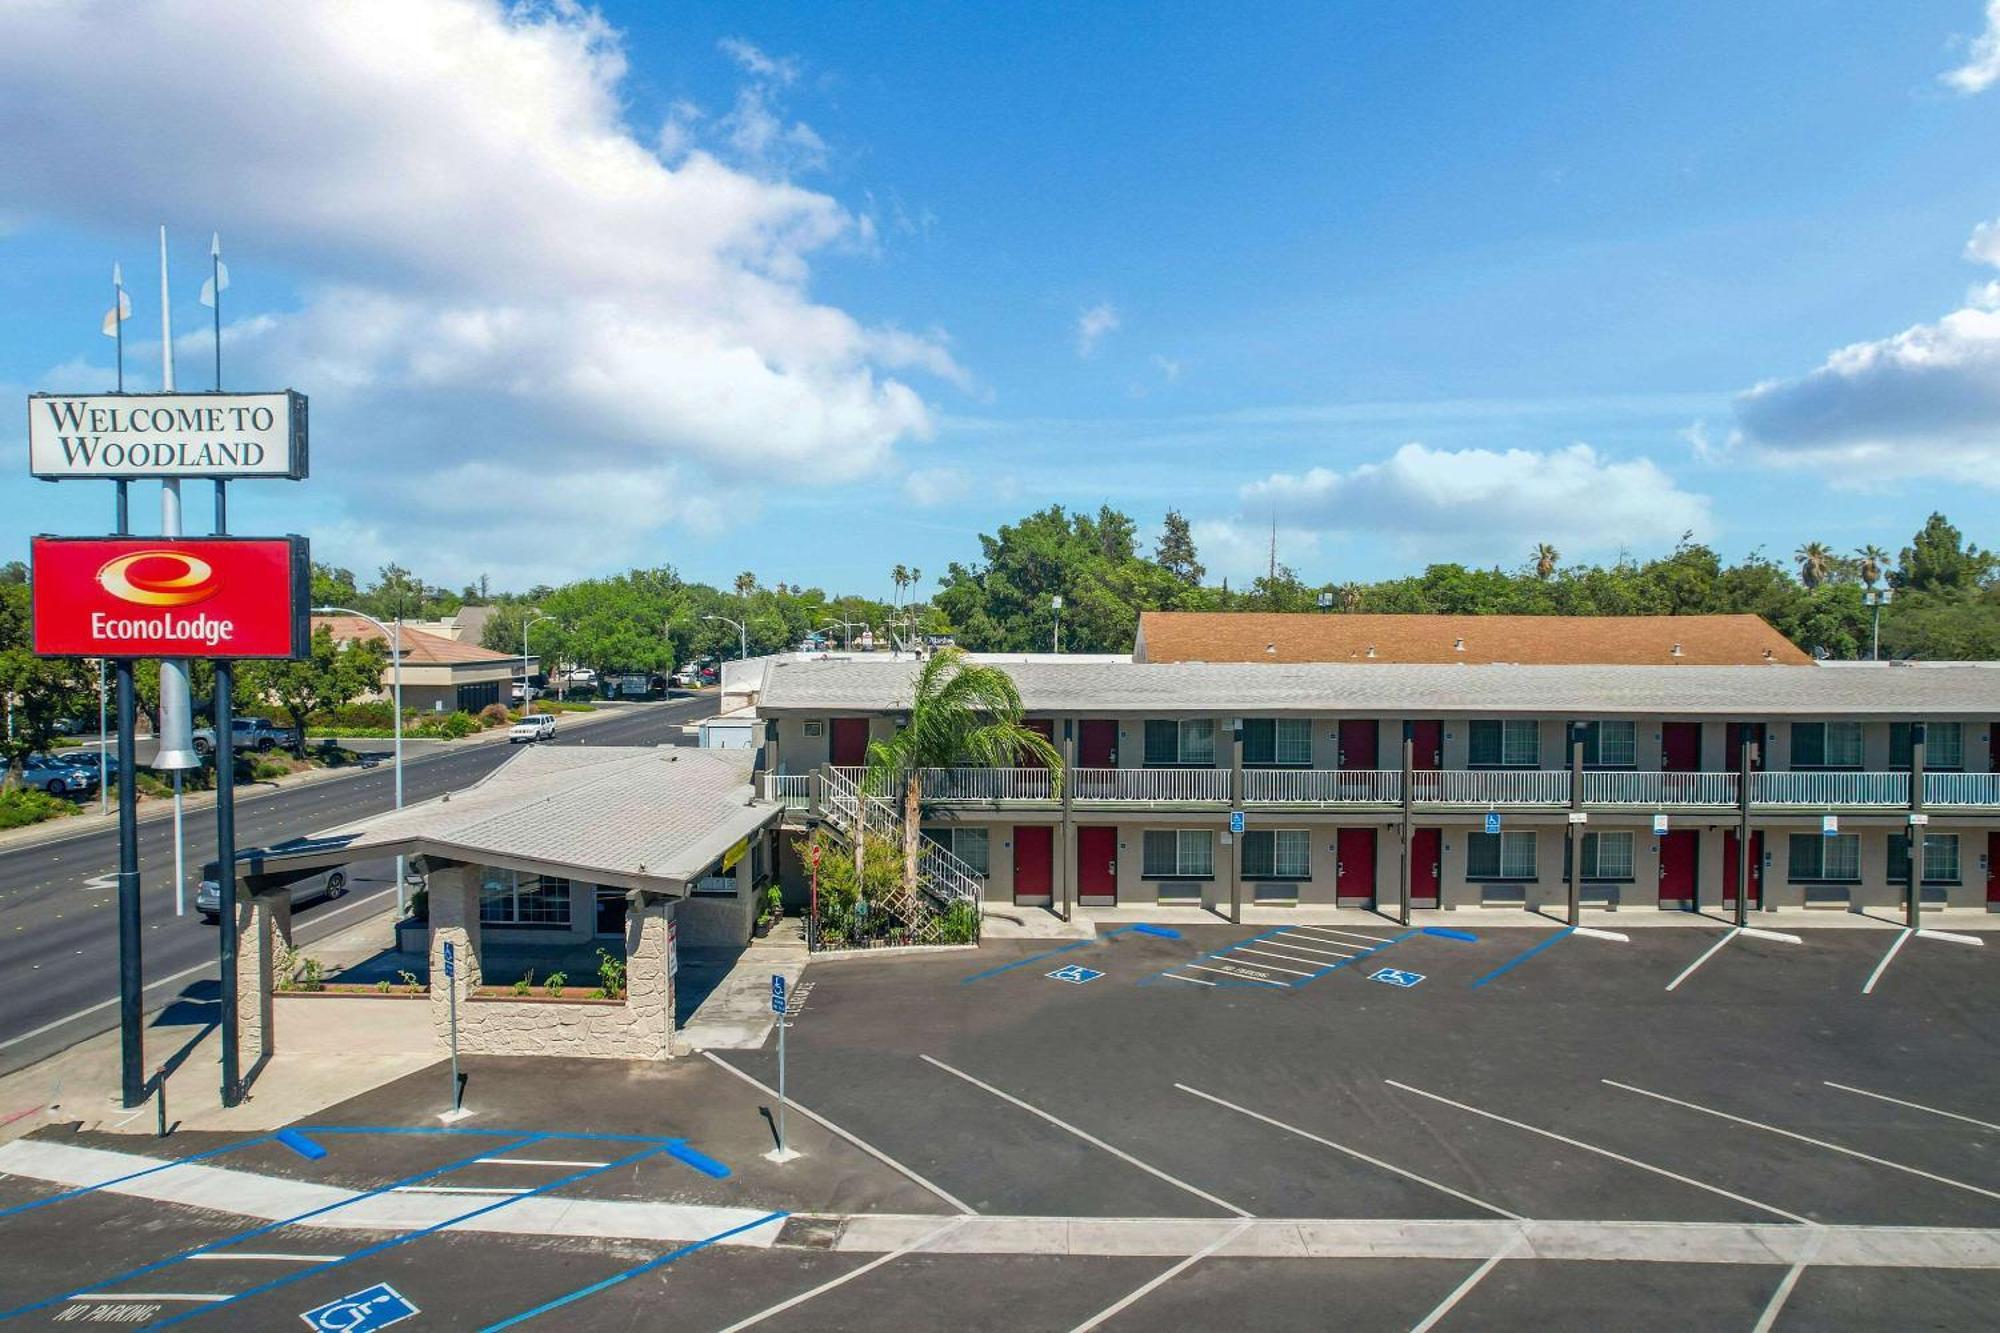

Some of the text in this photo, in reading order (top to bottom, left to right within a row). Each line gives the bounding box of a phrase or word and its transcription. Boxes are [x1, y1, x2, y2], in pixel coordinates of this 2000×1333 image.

[46, 402, 274, 433] WELCOME TO
[59, 436, 265, 467] WOODLAND
[52, 1304, 162, 1322] NO PARKING
